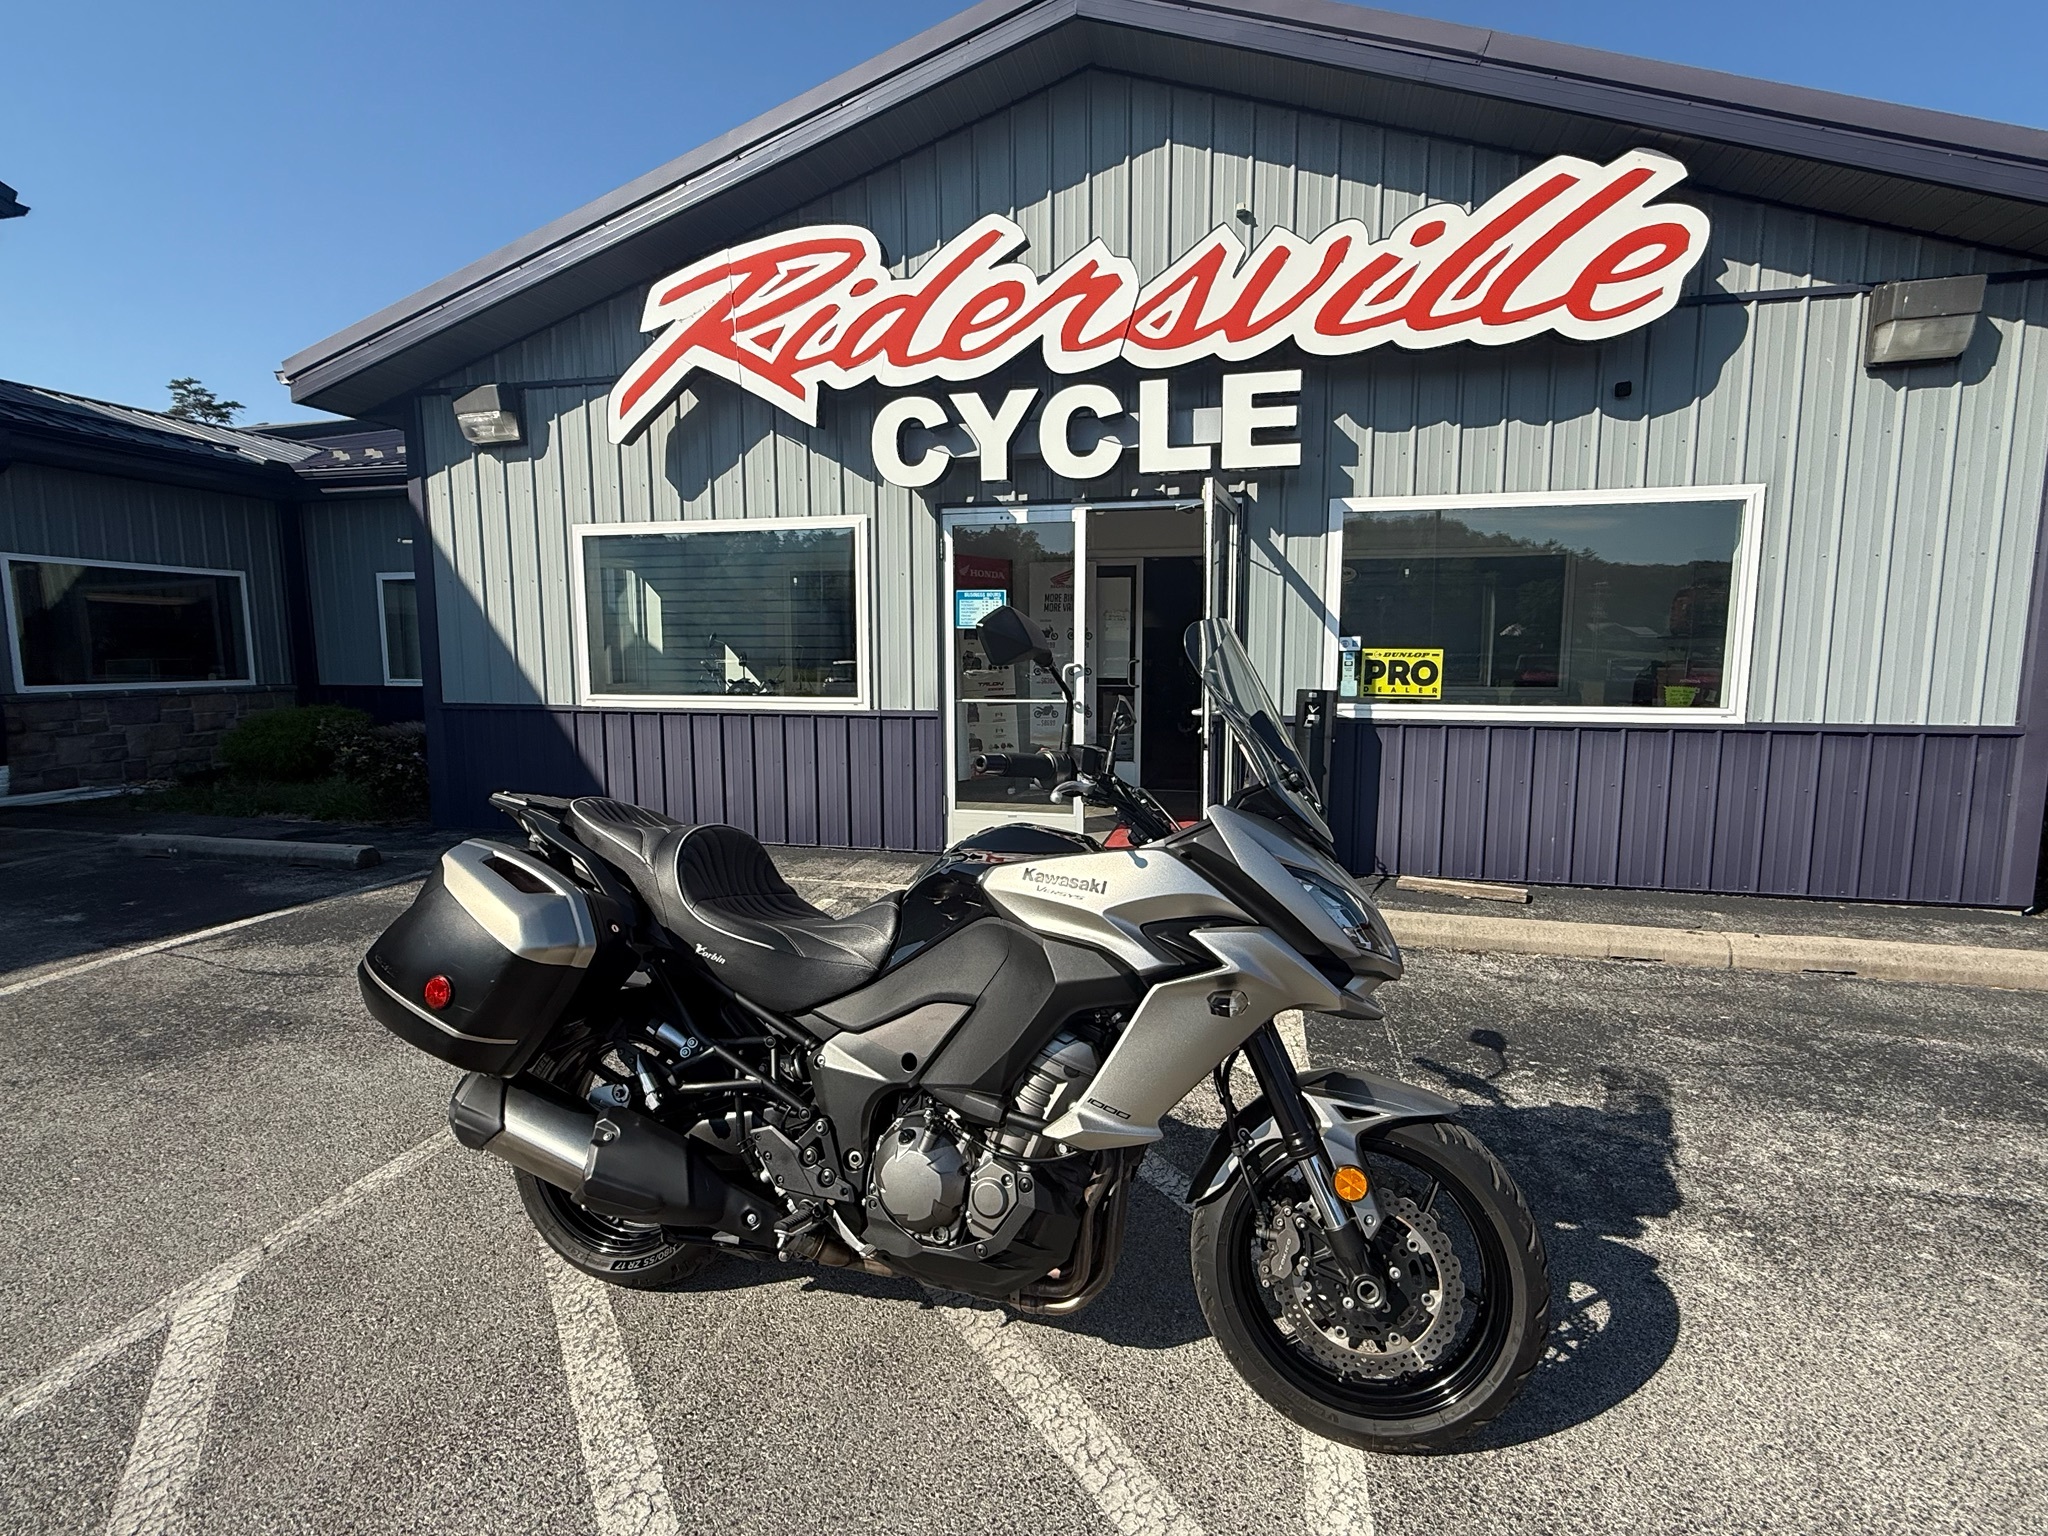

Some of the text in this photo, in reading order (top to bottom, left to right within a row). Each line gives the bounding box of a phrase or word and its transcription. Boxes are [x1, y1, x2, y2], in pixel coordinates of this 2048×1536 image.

[609, 149, 1711, 443] Ridersville
[871, 369, 1303, 488] CYCLE
[969, 569, 1006, 580] HONDA
[1043, 603, 1061, 612] MORE
[1044, 593, 1062, 602] MORE
[1363, 659, 1439, 687] PRO
[1022, 867, 1107, 895] Kawasaki
[695, 943, 726, 965] Corbin
[1087, 1097, 1131, 1120] 1000
[614, 1261, 626, 1270] 17
[627, 1259, 641, 1270] ZR
